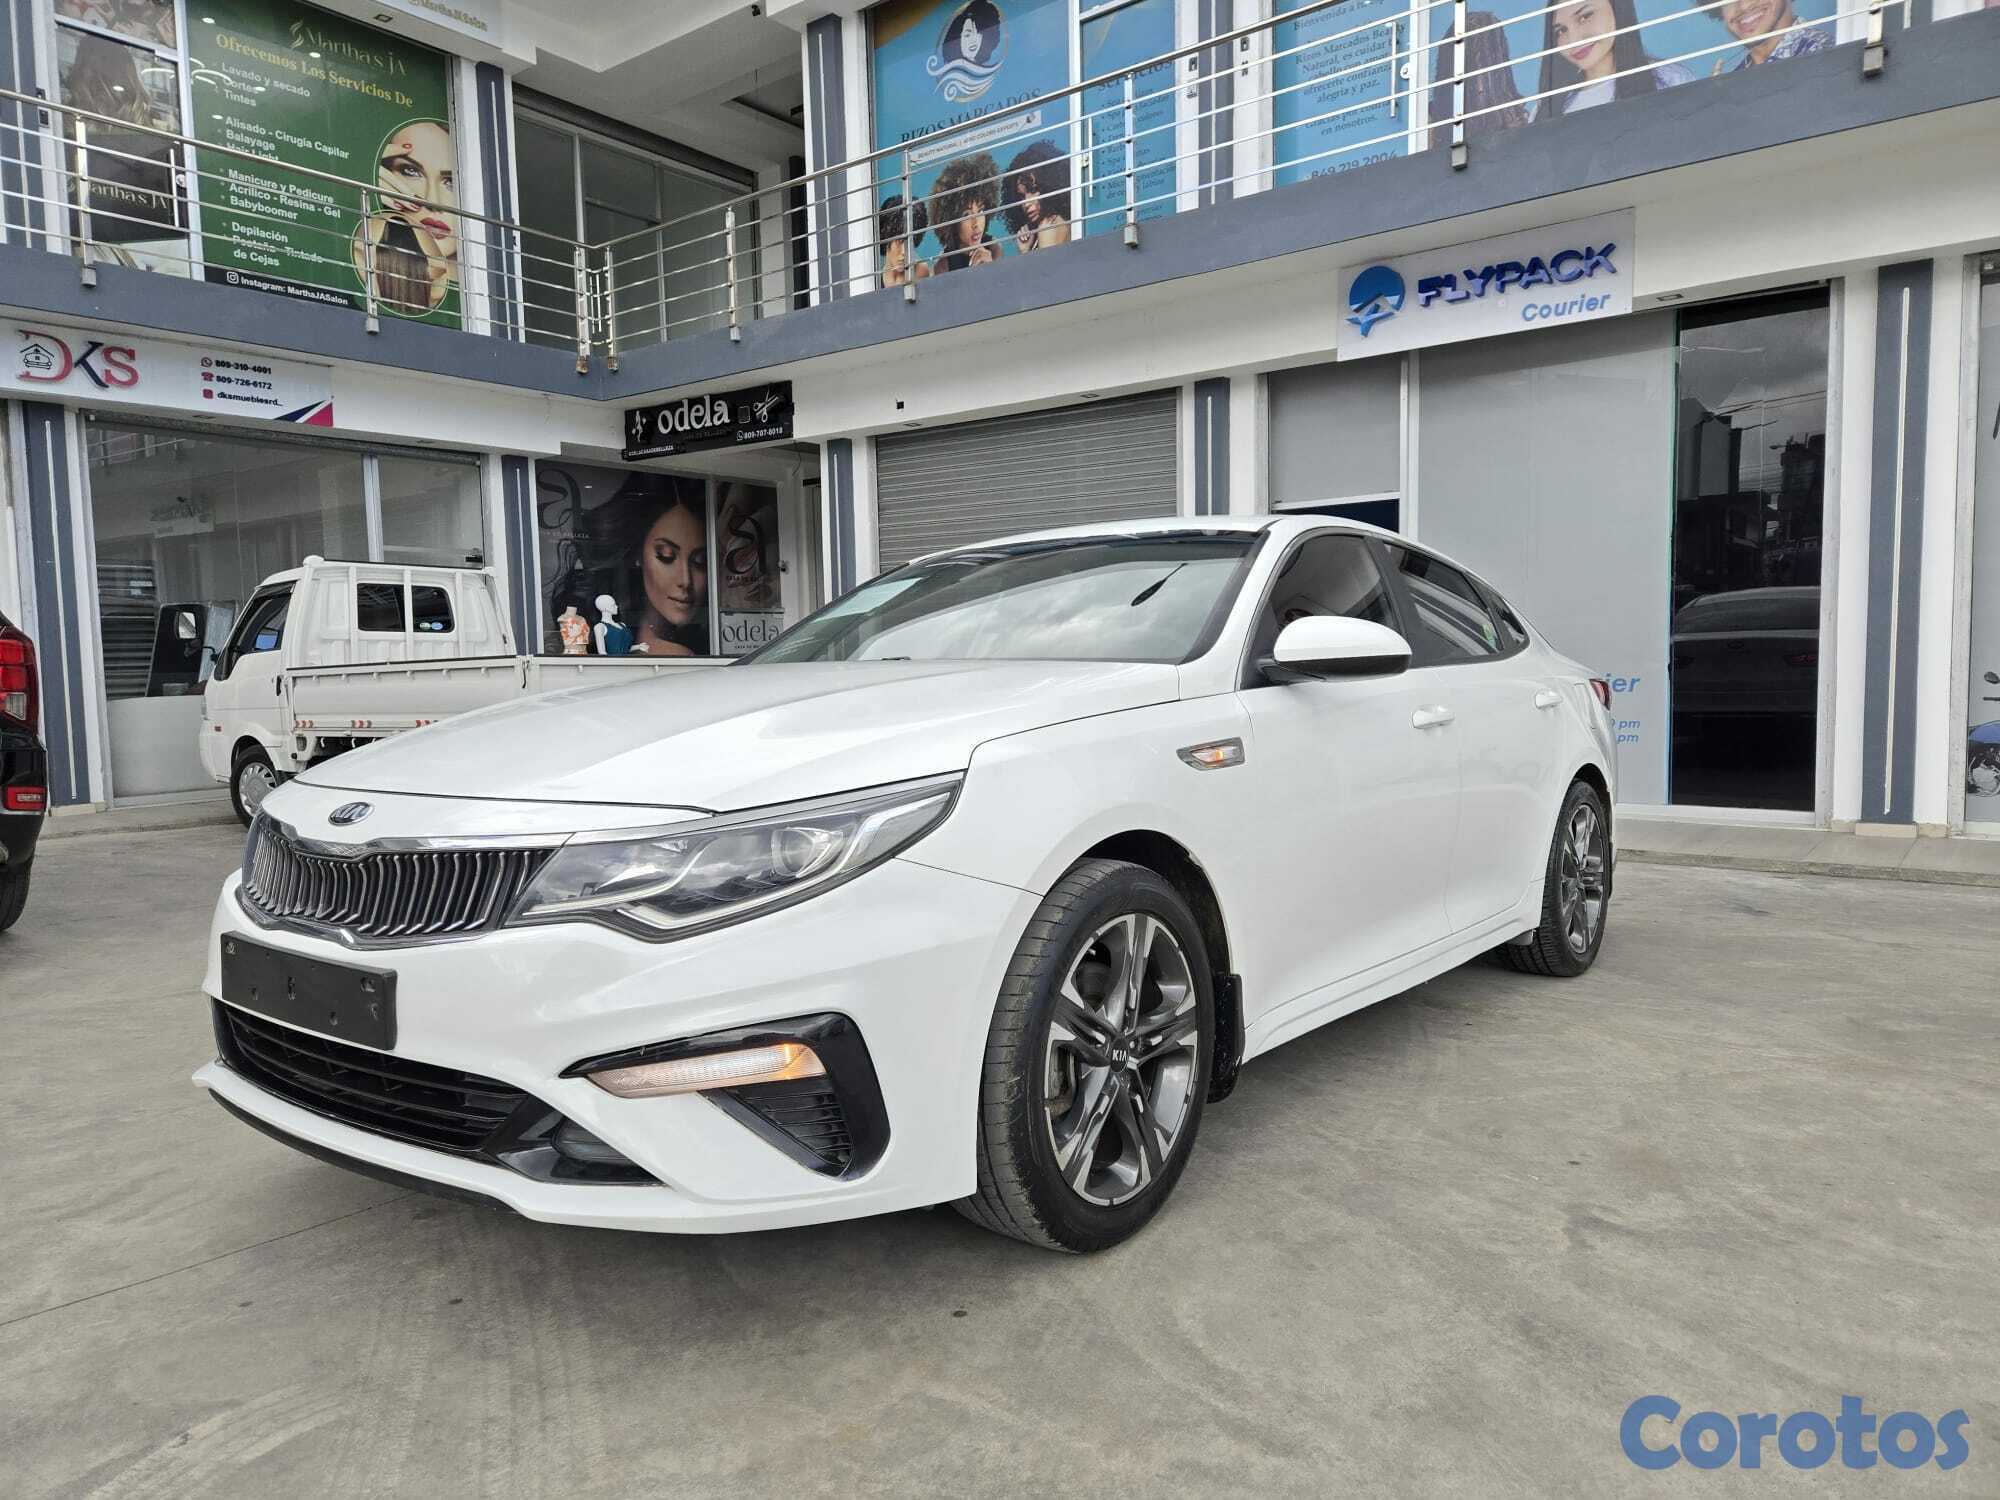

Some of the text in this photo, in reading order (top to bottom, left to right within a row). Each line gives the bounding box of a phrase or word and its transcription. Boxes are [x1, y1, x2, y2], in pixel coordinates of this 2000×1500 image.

[216, 33, 413, 108] Ofrecemos Los Servicios De
[222, 62, 262, 82] Lavado
[273, 80, 311, 97] secado
[224, 88, 257, 107] Tintes
[225, 116, 266, 135] Alisado
[314, 141, 350, 159] Capilar
[226, 129, 276, 151] Balayage
[228, 168, 279, 190] Manicure
[289, 184, 334, 204] Pedicure
[229, 195, 298, 220] Babyboomer
[280, 195, 315, 212] Resina
[323, 205, 341, 218] Gel
[231, 221, 288, 243] Depilación
[233, 249, 280, 266] de Cejas
[241, 276, 286, 293] Instagram:
[1418, 242, 1617, 308] FLYPACK
[1521, 292, 1612, 323] Courier
[17, 329, 140, 389] DKS
[657, 394, 731, 435] odela
[722, 619, 779, 643] odela
[1618, 720, 1641, 730] pm
[1617, 734, 1639, 744] pm
[1112, 1049, 1127, 1062] KIA
